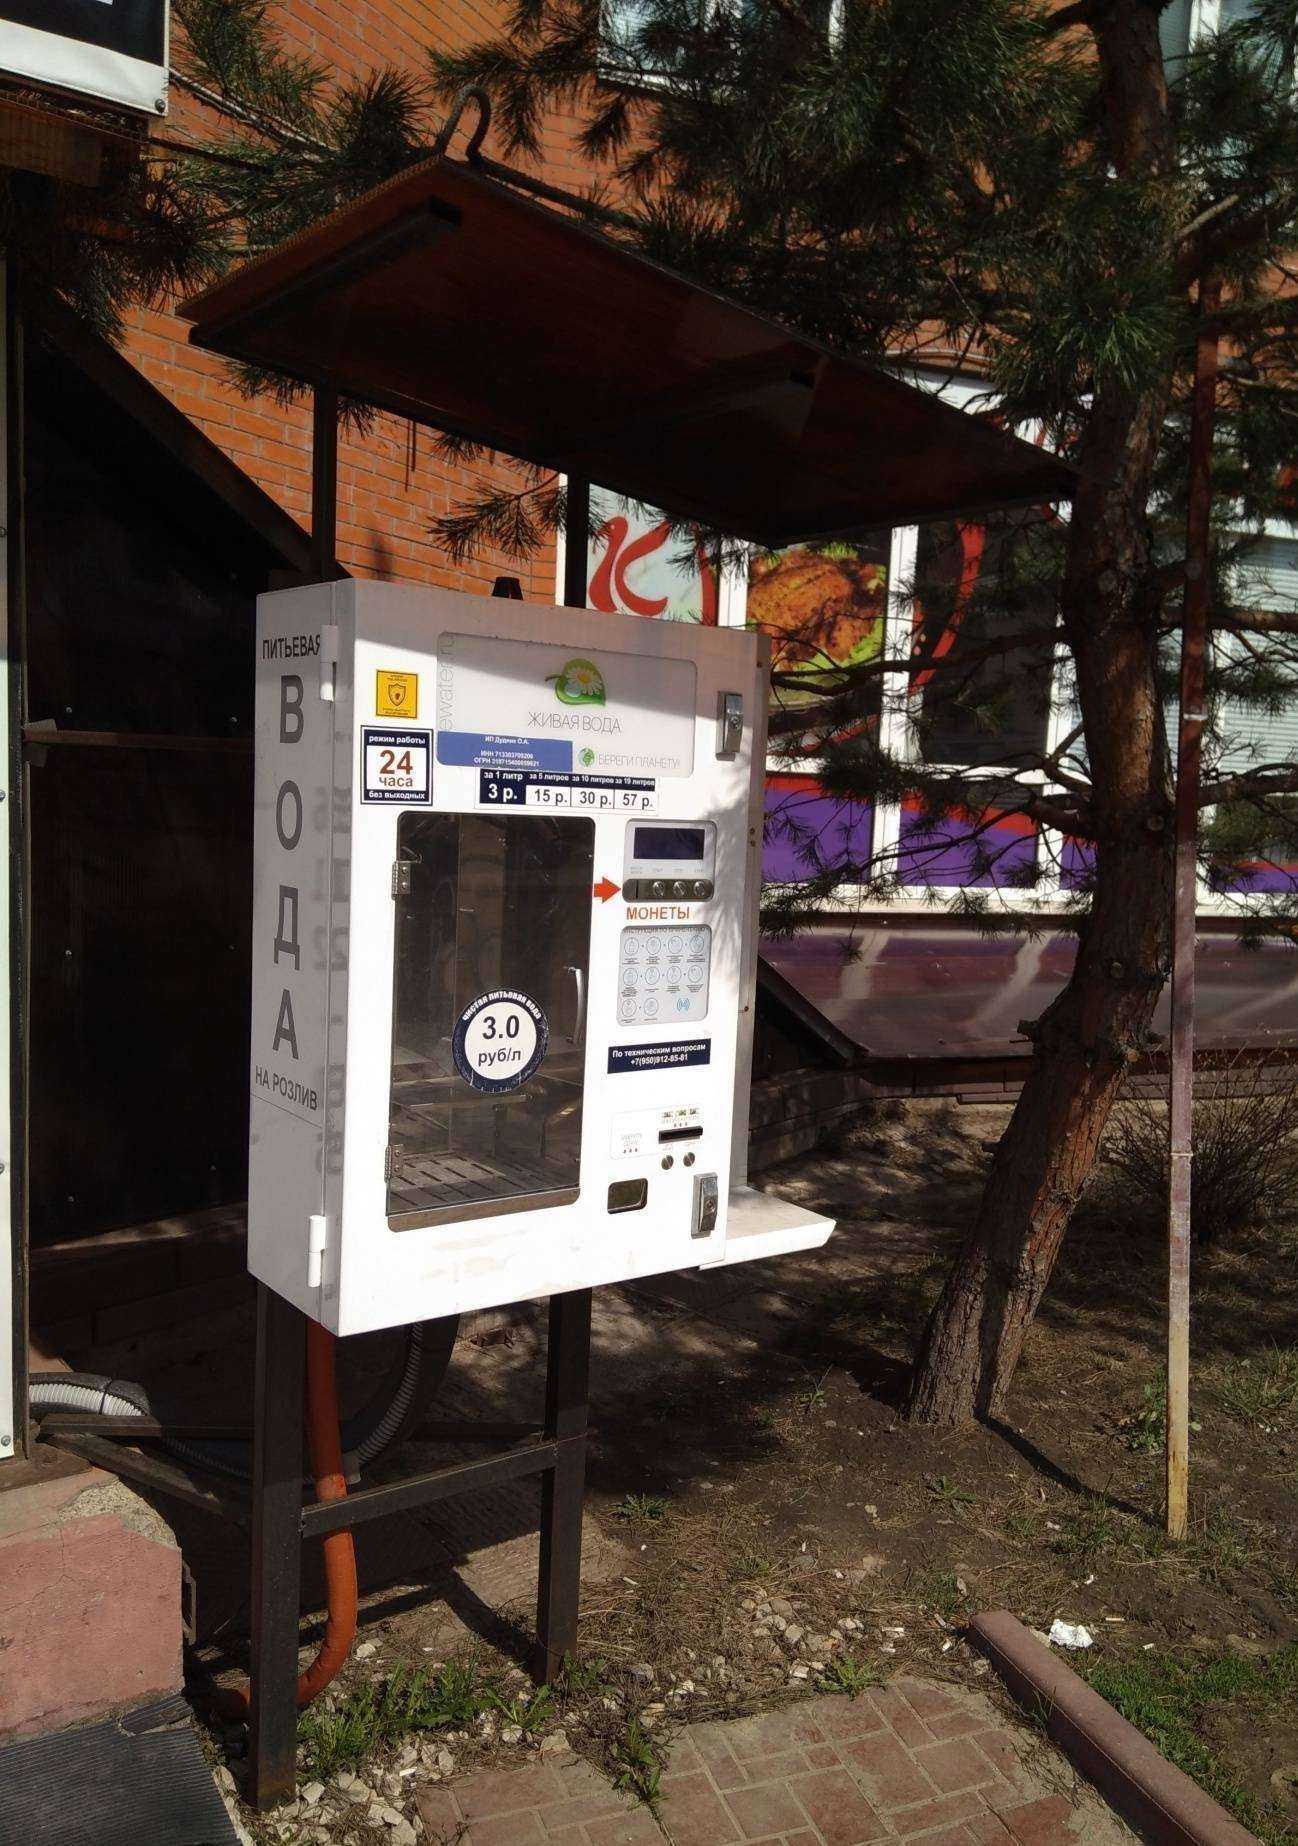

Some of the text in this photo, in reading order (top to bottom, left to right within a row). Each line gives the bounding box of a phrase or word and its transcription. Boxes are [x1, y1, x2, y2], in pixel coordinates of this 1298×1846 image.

[262, 634, 320, 660] ПИТЬЕВАЯ
[527, 711, 621, 734] ЖИВАЯ ВОДА
[368, 735, 426, 745] режим работы
[379, 749, 414, 775] 24
[379, 776, 414, 787] часа
[502, 773, 523, 781] литр
[544, 774, 569, 782] литров
[590, 776, 615, 784] литров
[623, 776, 633, 784] 19
[632, 777, 655, 786] литров
[368, 790, 426, 801] без выходных
[488, 783, 518, 803] 3 р.
[535, 788, 568, 806] 15 р.
[579, 791, 612, 809] 30 р.
[622, 793, 654, 810] 57 р.
[626, 906, 691, 920] МОНЕТЫ
[461, 990, 542, 1021] чистая питьевая вода
[482, 1015, 520, 1040] 3.0
[478, 1047, 522, 1067] руб/л
[612, 1043, 706, 1058] По техническим вопросам
[255, 1065, 318, 1111] НА РОЗЛИВ
